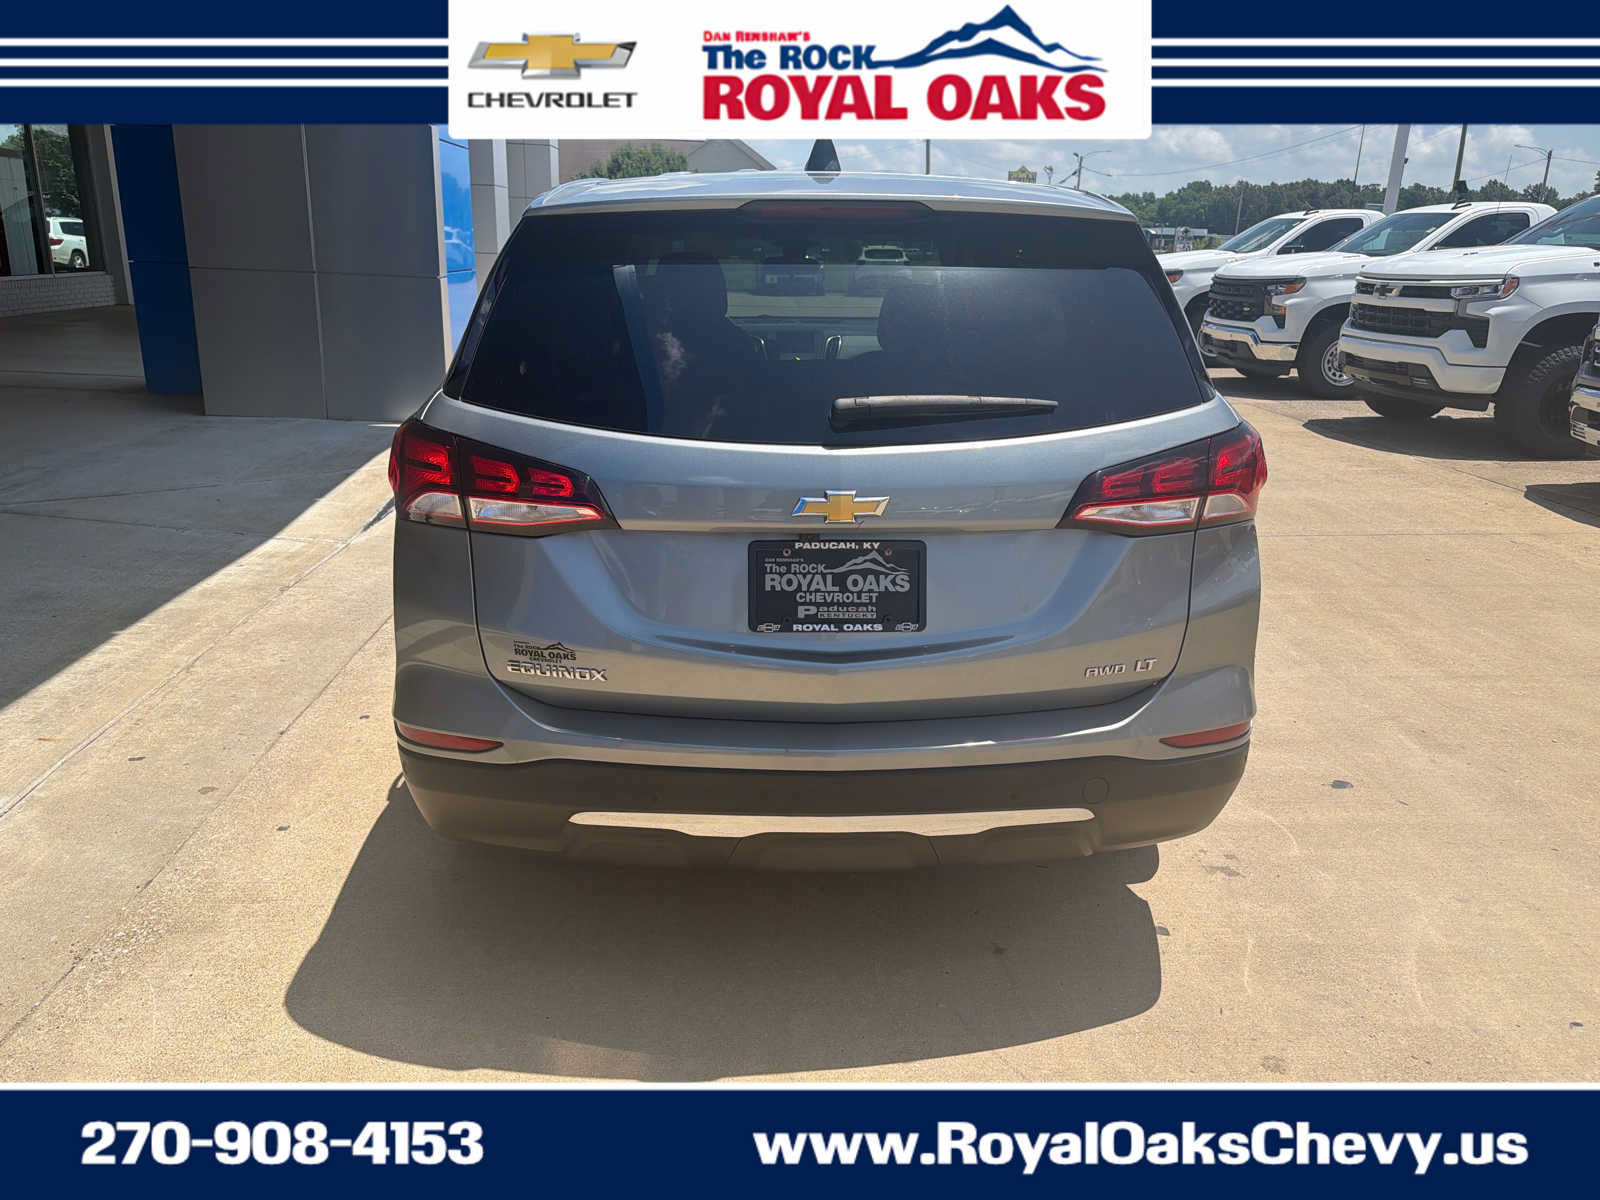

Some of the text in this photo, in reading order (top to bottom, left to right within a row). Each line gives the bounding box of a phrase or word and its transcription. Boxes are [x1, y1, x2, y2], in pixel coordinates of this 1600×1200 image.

[764, 563, 826, 573] The ROCK
[765, 574, 911, 592] ROYAL OAKS
[796, 592, 879, 603] CHEVROLET
[797, 605, 877, 619] Paducah
[792, 623, 884, 632] ROYAL OAKS
[514, 648, 577, 661] ROYAL OAKS
[506, 660, 609, 681] EQUINOX
[1084, 656, 1158, 678] AWD LT
